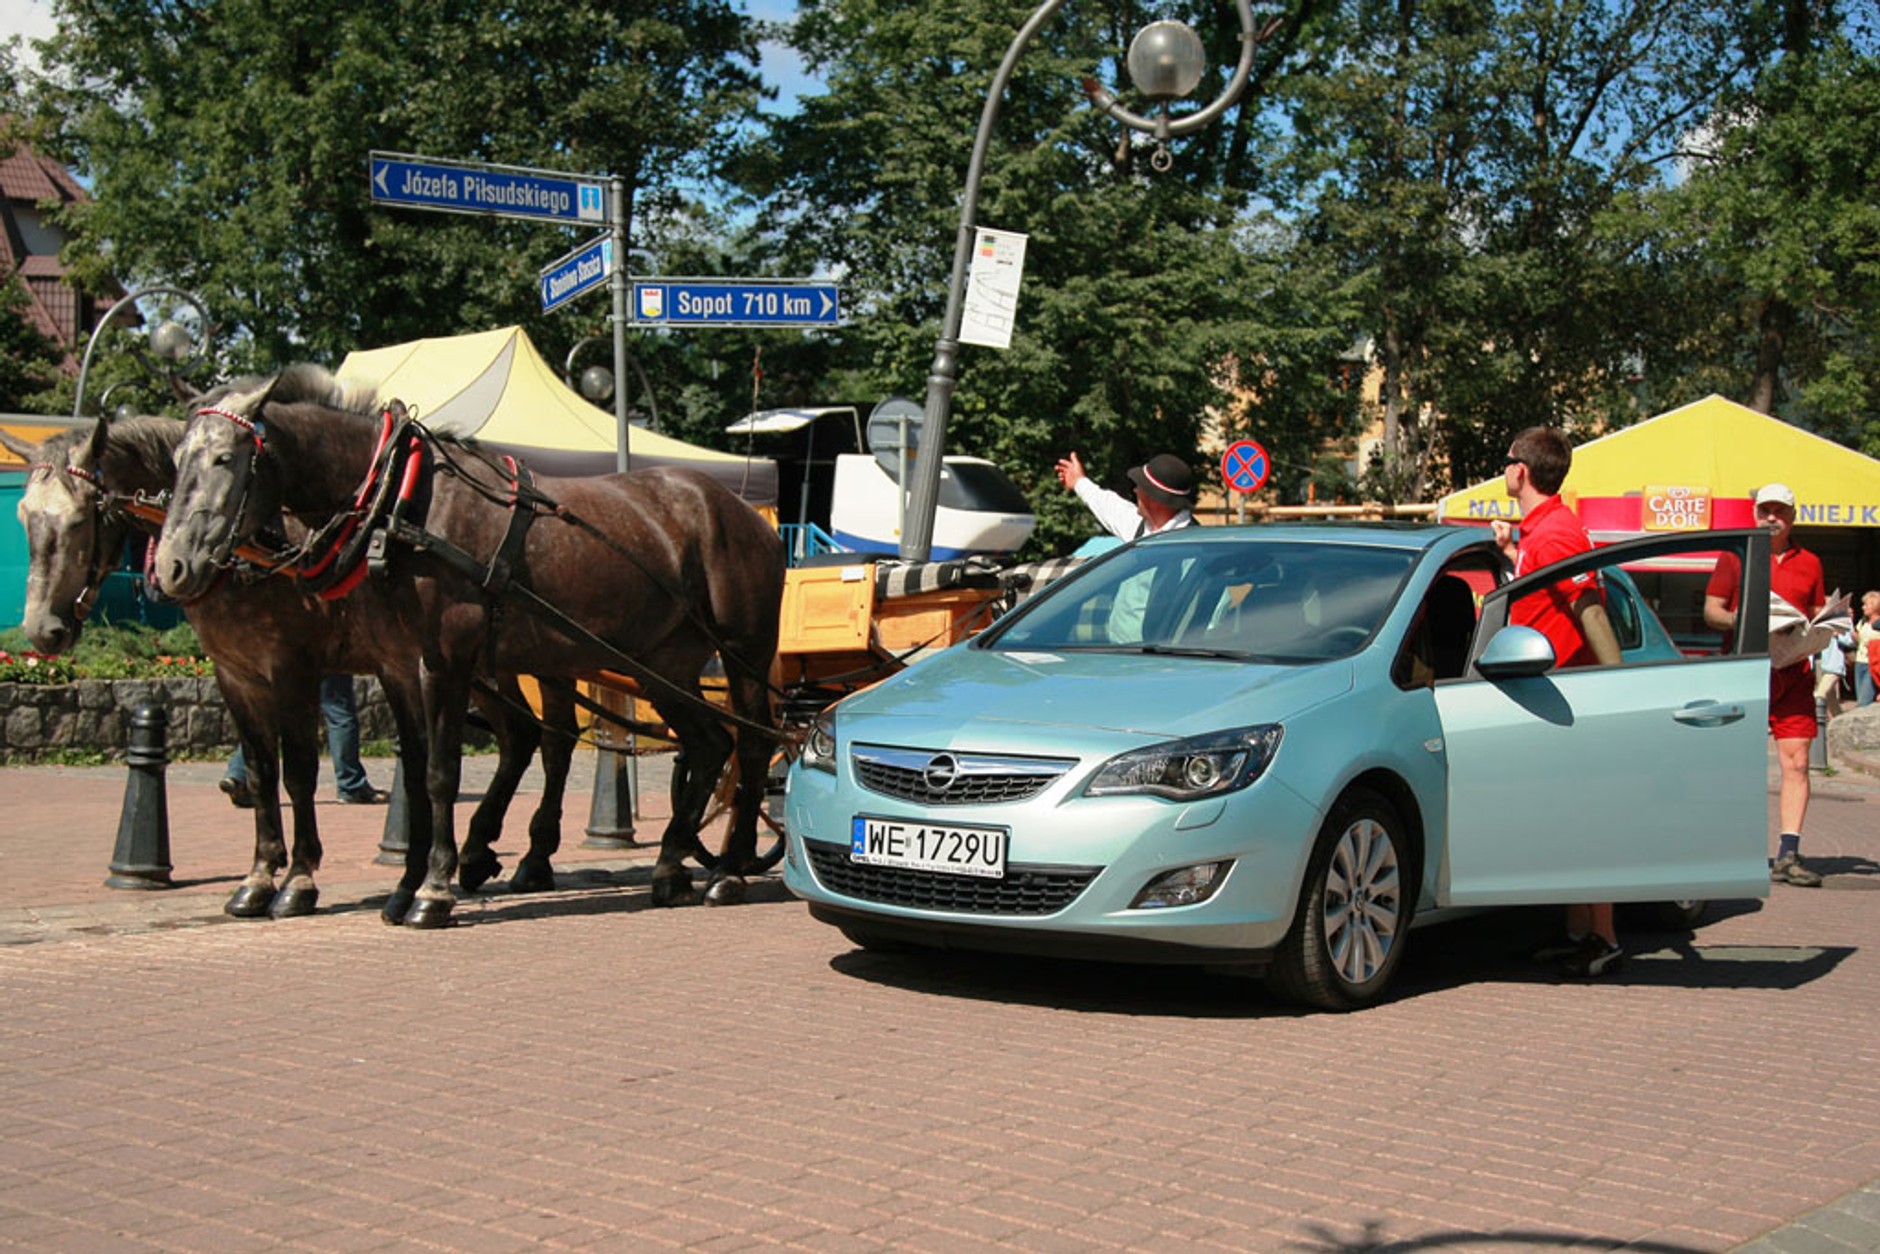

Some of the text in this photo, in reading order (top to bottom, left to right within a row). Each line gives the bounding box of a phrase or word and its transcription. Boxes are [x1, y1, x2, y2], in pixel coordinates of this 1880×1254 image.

[402, 168, 569, 215] Józefa Piłsudskiego
[678, 291, 812, 319] Sopot 710 km
[1469, 499, 1524, 518] NAJ
[1648, 495, 1705, 515] CARTE
[1655, 512, 1699, 529] D'OR
[869, 824, 1000, 866] WE 1729U
